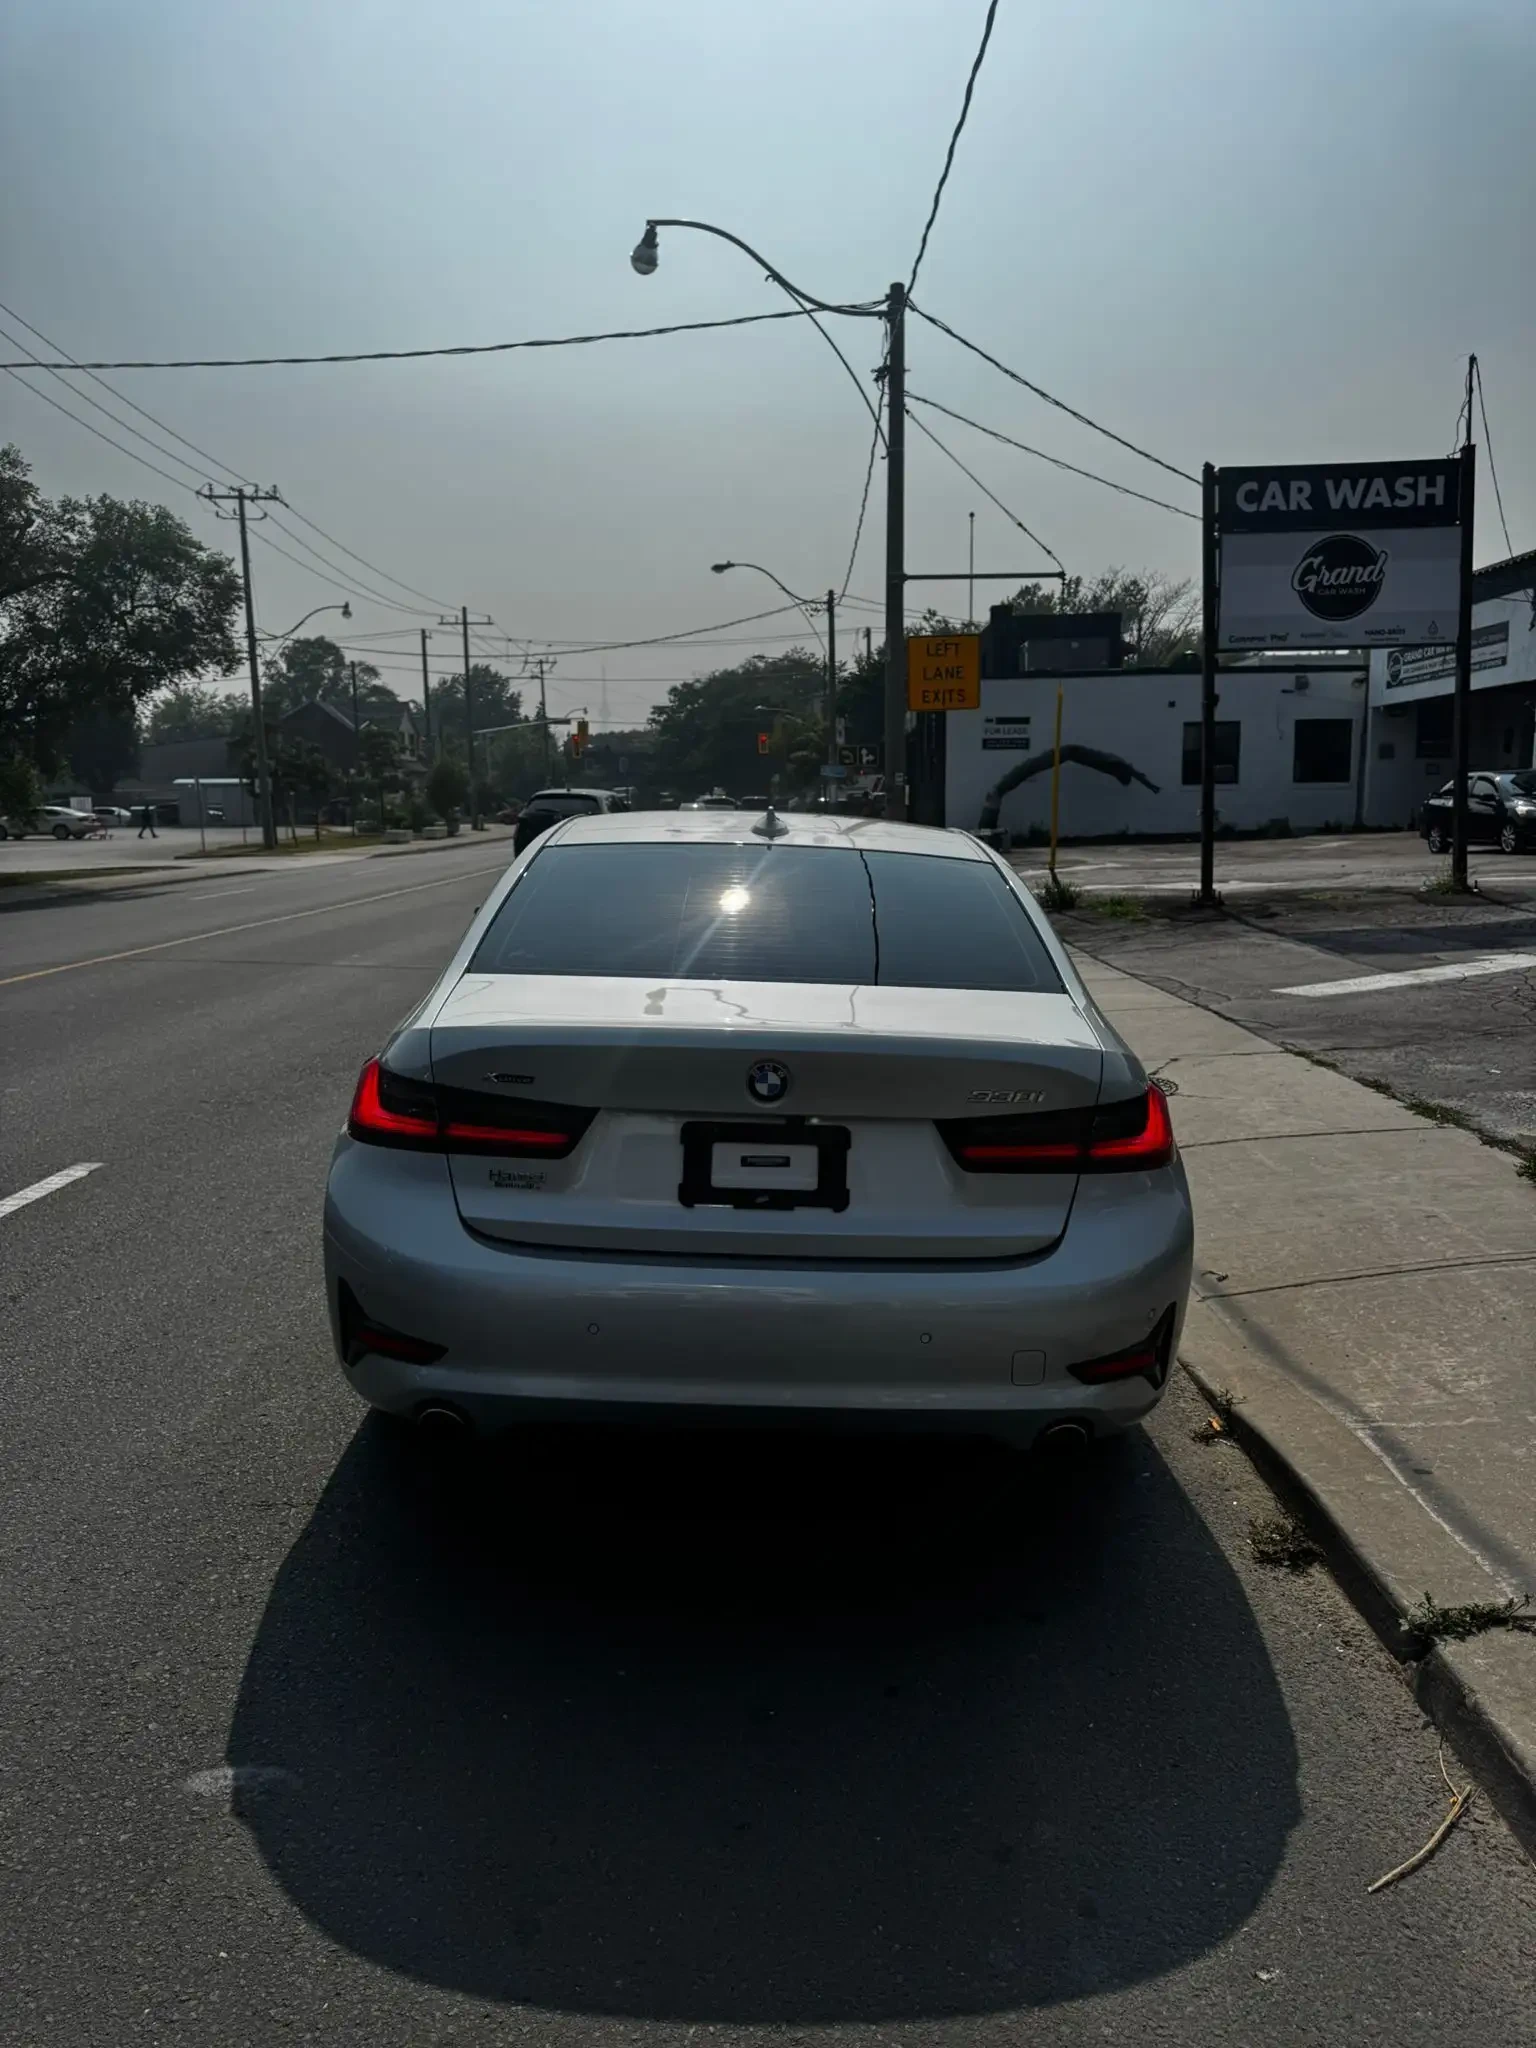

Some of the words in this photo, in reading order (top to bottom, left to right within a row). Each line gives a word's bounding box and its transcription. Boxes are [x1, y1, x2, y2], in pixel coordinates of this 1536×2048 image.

[1236, 481, 1313, 513] CAR
[1325, 475, 1446, 510] WASH
[1292, 549, 1388, 593] Grand
[1317, 588, 1337, 596] CAR
[1338, 587, 1366, 596] WASH
[926, 641, 961, 657] LEFT
[923, 665, 966, 681] LANE
[921, 688, 967, 704] EXITS
